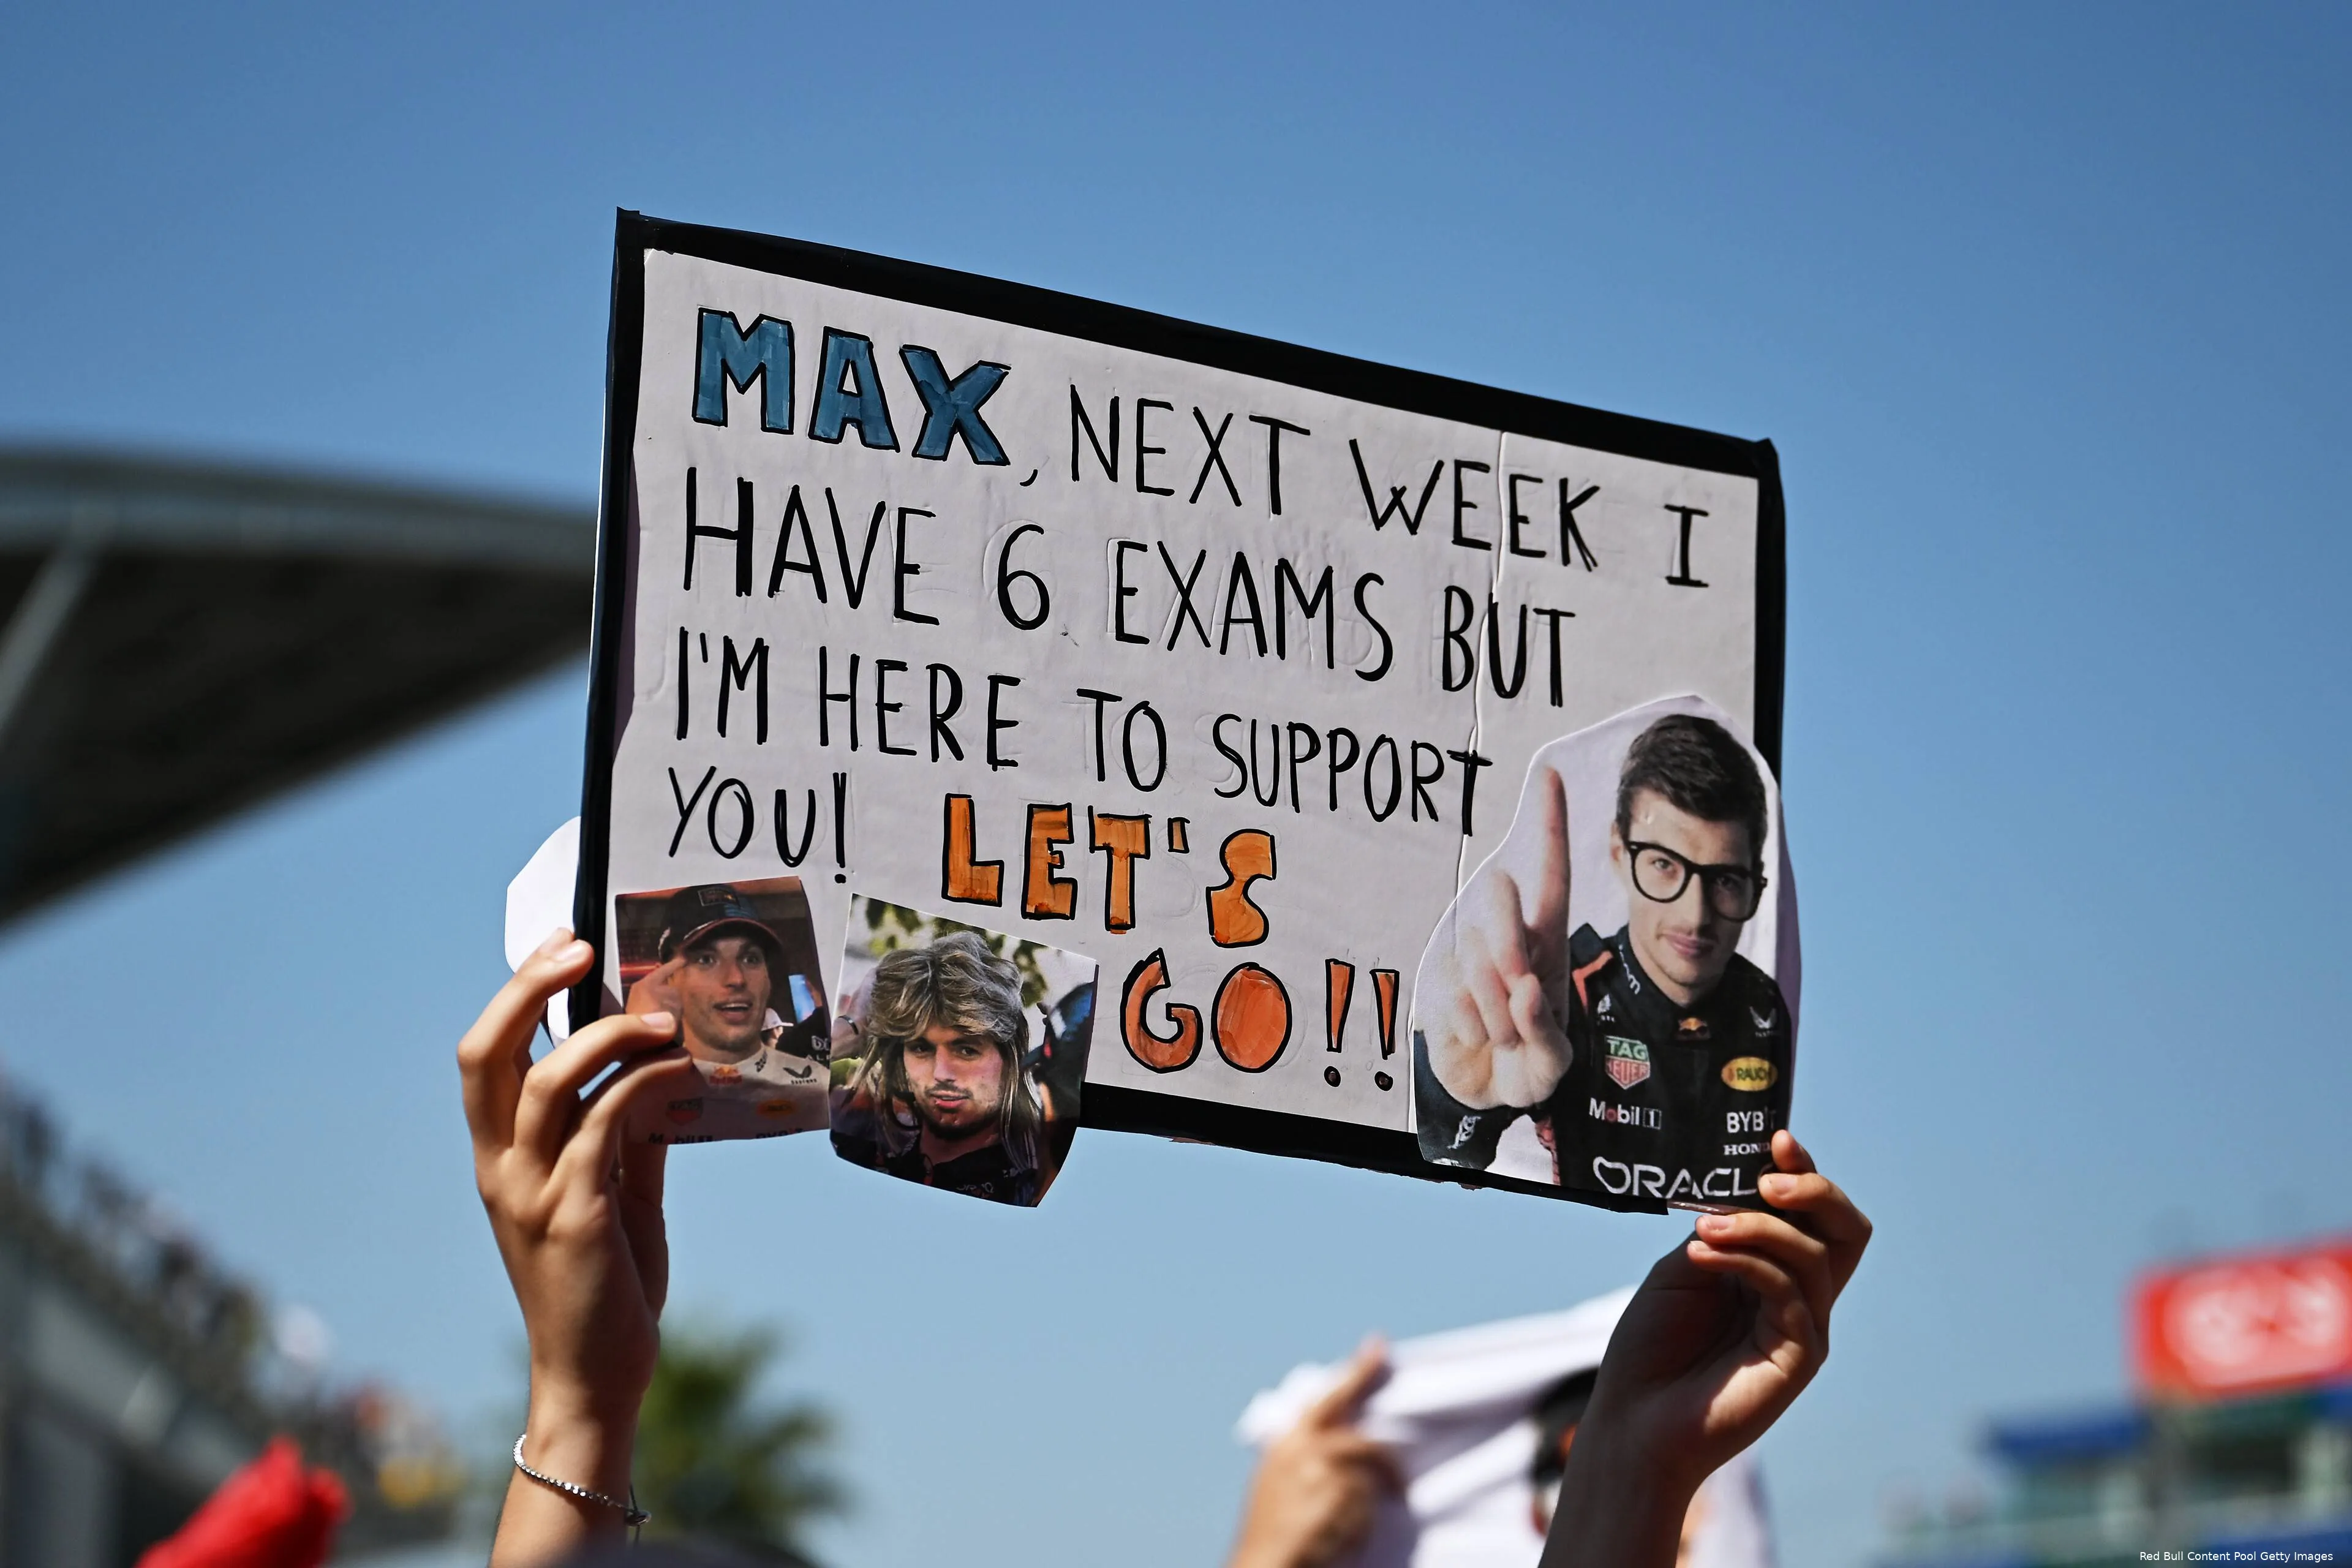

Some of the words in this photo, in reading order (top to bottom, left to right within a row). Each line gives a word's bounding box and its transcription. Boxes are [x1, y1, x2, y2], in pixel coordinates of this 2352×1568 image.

[691, 307, 1038, 486] MAX,
[1070, 384, 1311, 516] NEXT
[1349, 438, 1600, 572] WEEK
[1664, 504, 1709, 588] I
[683, 467, 940, 626] HAVE
[997, 524, 1050, 631] 6
[1115, 540, 1393, 682] EXAMS
[1442, 585, 1576, 708] BUT
[676, 626, 770, 745] I'M
[819, 646, 1021, 772] HERE
[1076, 688, 1167, 793] TO
[1212, 714, 1493, 837] SUPPORT
[668, 766, 847, 884] YOU!
[941, 793, 1277, 949] LET'S
[1120, 947, 1400, 1091] GO!!
[1606, 1039, 1646, 1060] TAG
[1589, 1097, 1640, 1126] Mobil
[1593, 1156, 1758, 1199] ORACL
[1723, 1142, 1771, 1156] HOND
